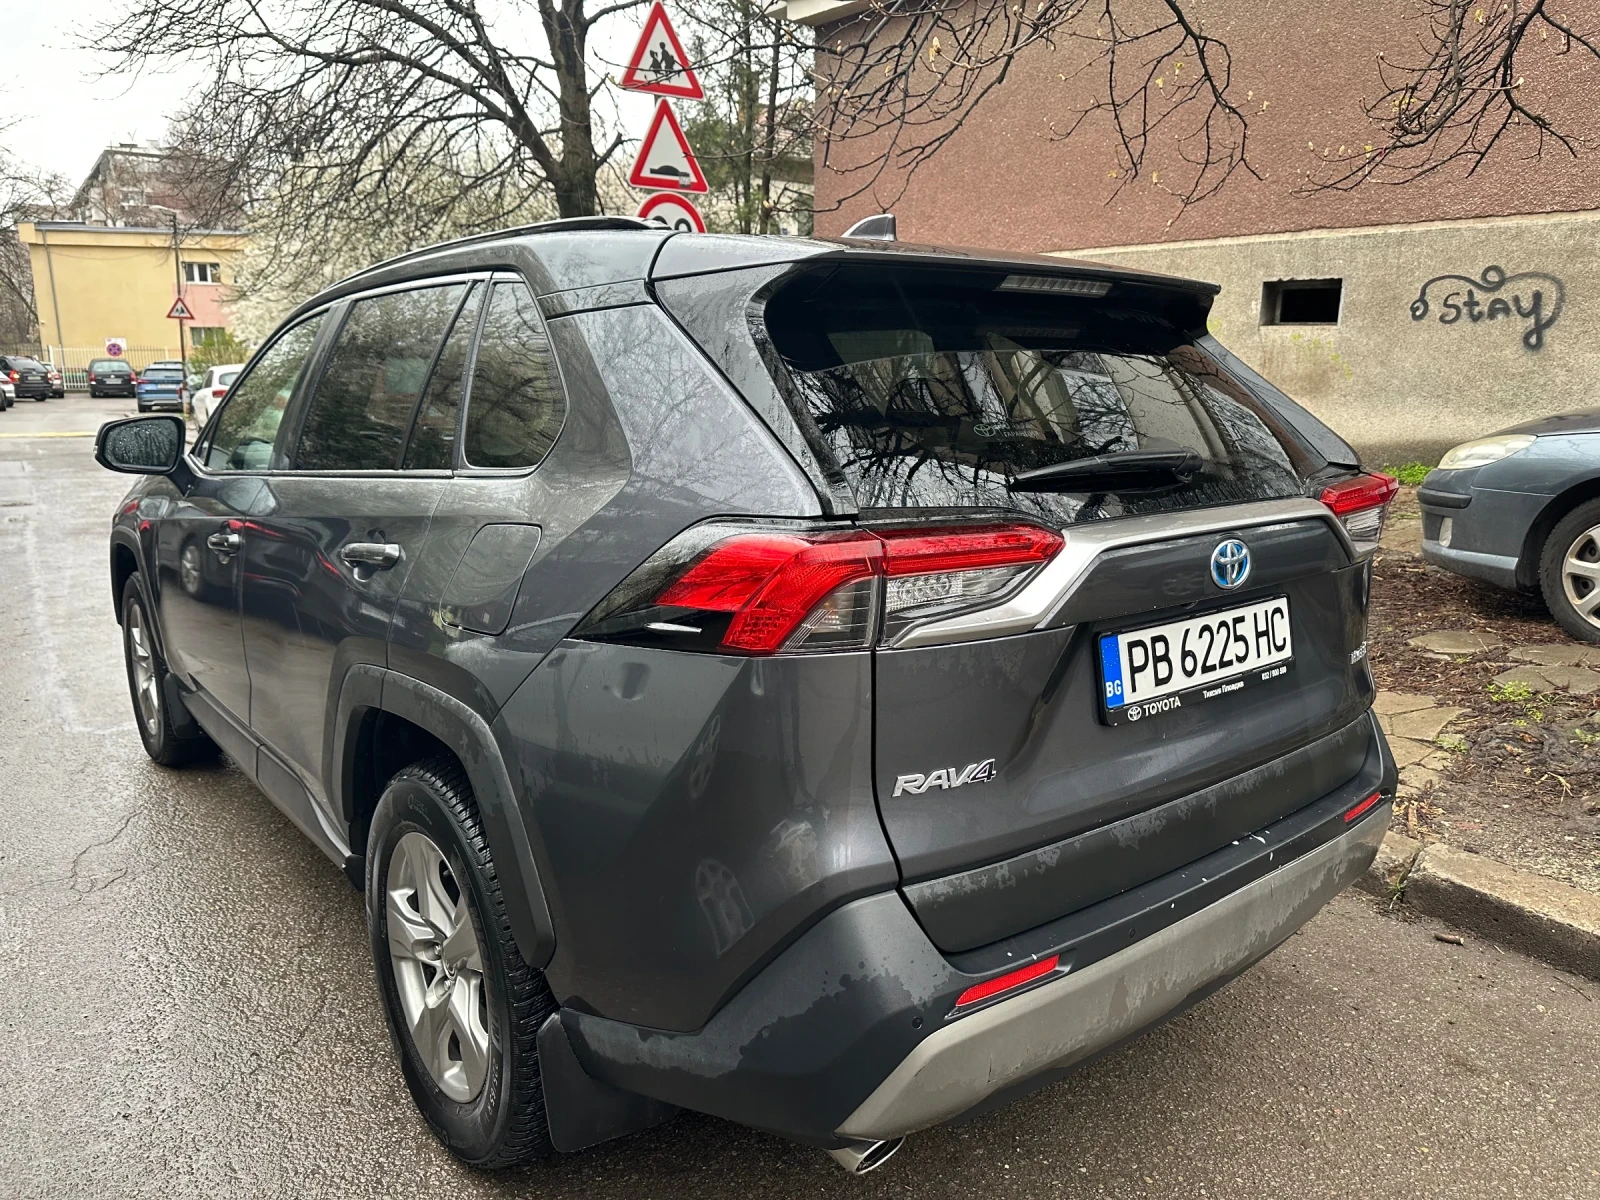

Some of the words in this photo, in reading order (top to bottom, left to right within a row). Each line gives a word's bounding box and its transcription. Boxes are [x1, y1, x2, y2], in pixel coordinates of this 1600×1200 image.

[1127, 634, 1173, 694] PB
[1180, 615, 1249, 678] 6225
[1253, 606, 1287, 659] HC
[1105, 680, 1122, 698] BG
[1142, 696, 1182, 717] TOYOTA
[892, 758, 997, 798] RAV4
